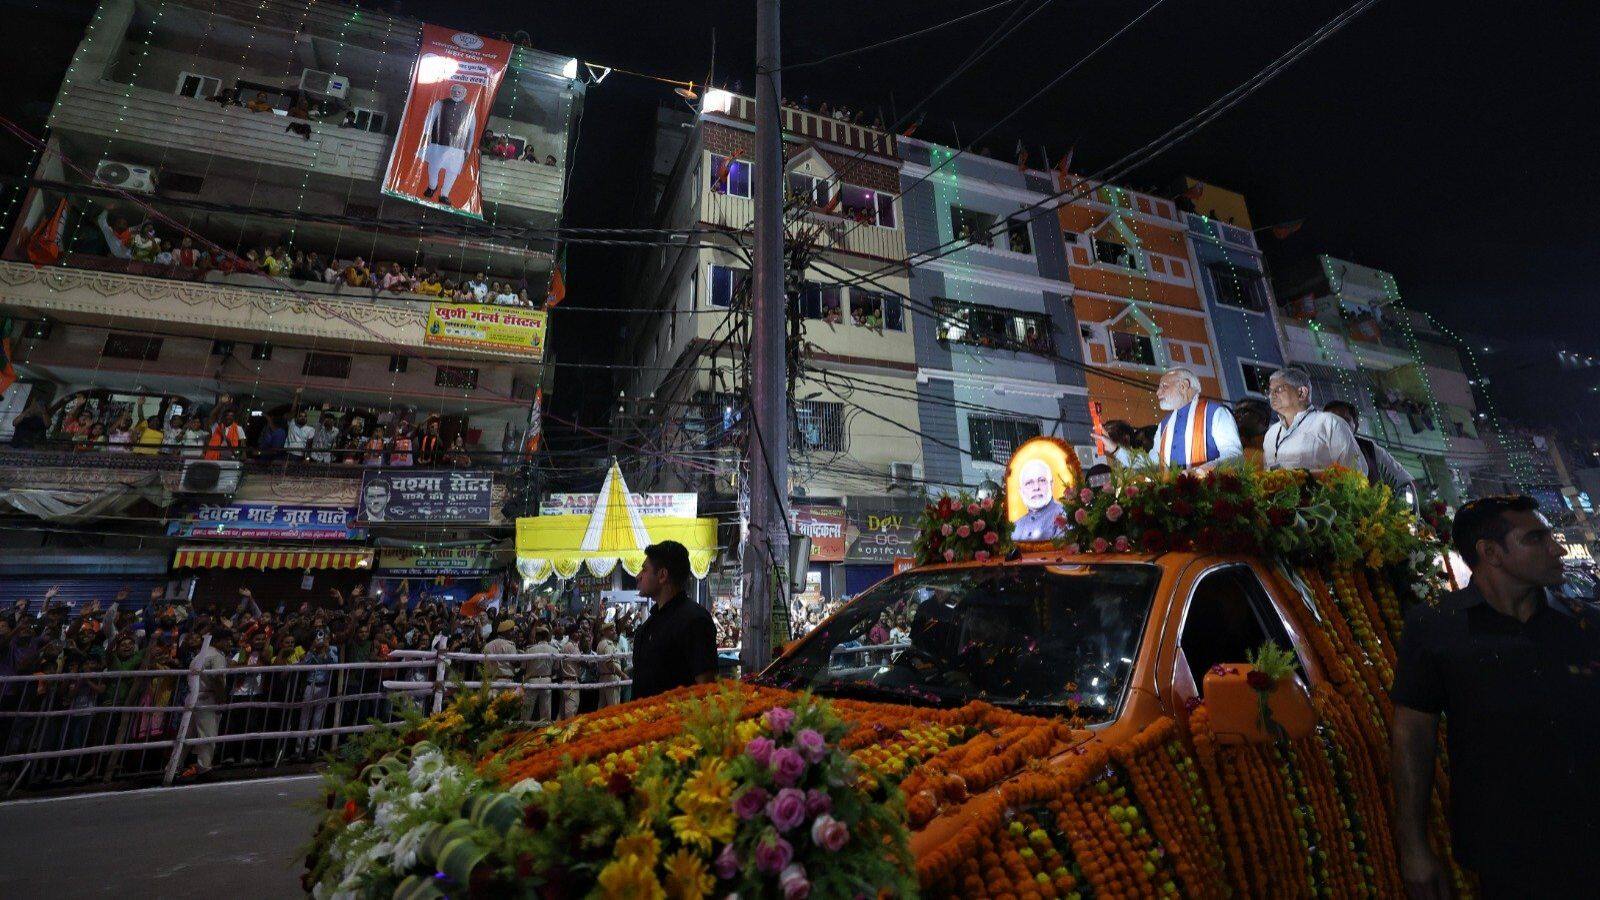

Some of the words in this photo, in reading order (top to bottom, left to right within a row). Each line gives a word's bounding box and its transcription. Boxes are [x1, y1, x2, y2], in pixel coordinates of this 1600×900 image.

[435, 306, 467, 320] खुशी
[470, 310, 500, 324] गर्ल्स
[390, 477, 444, 491] चश्मा
[449, 473, 491, 491] सेंटर
[248, 505, 279, 524] भाई
[282, 508, 313, 527] जूस
[316, 506, 350, 525] वाले
[865, 546, 907, 555] OPTICAL
